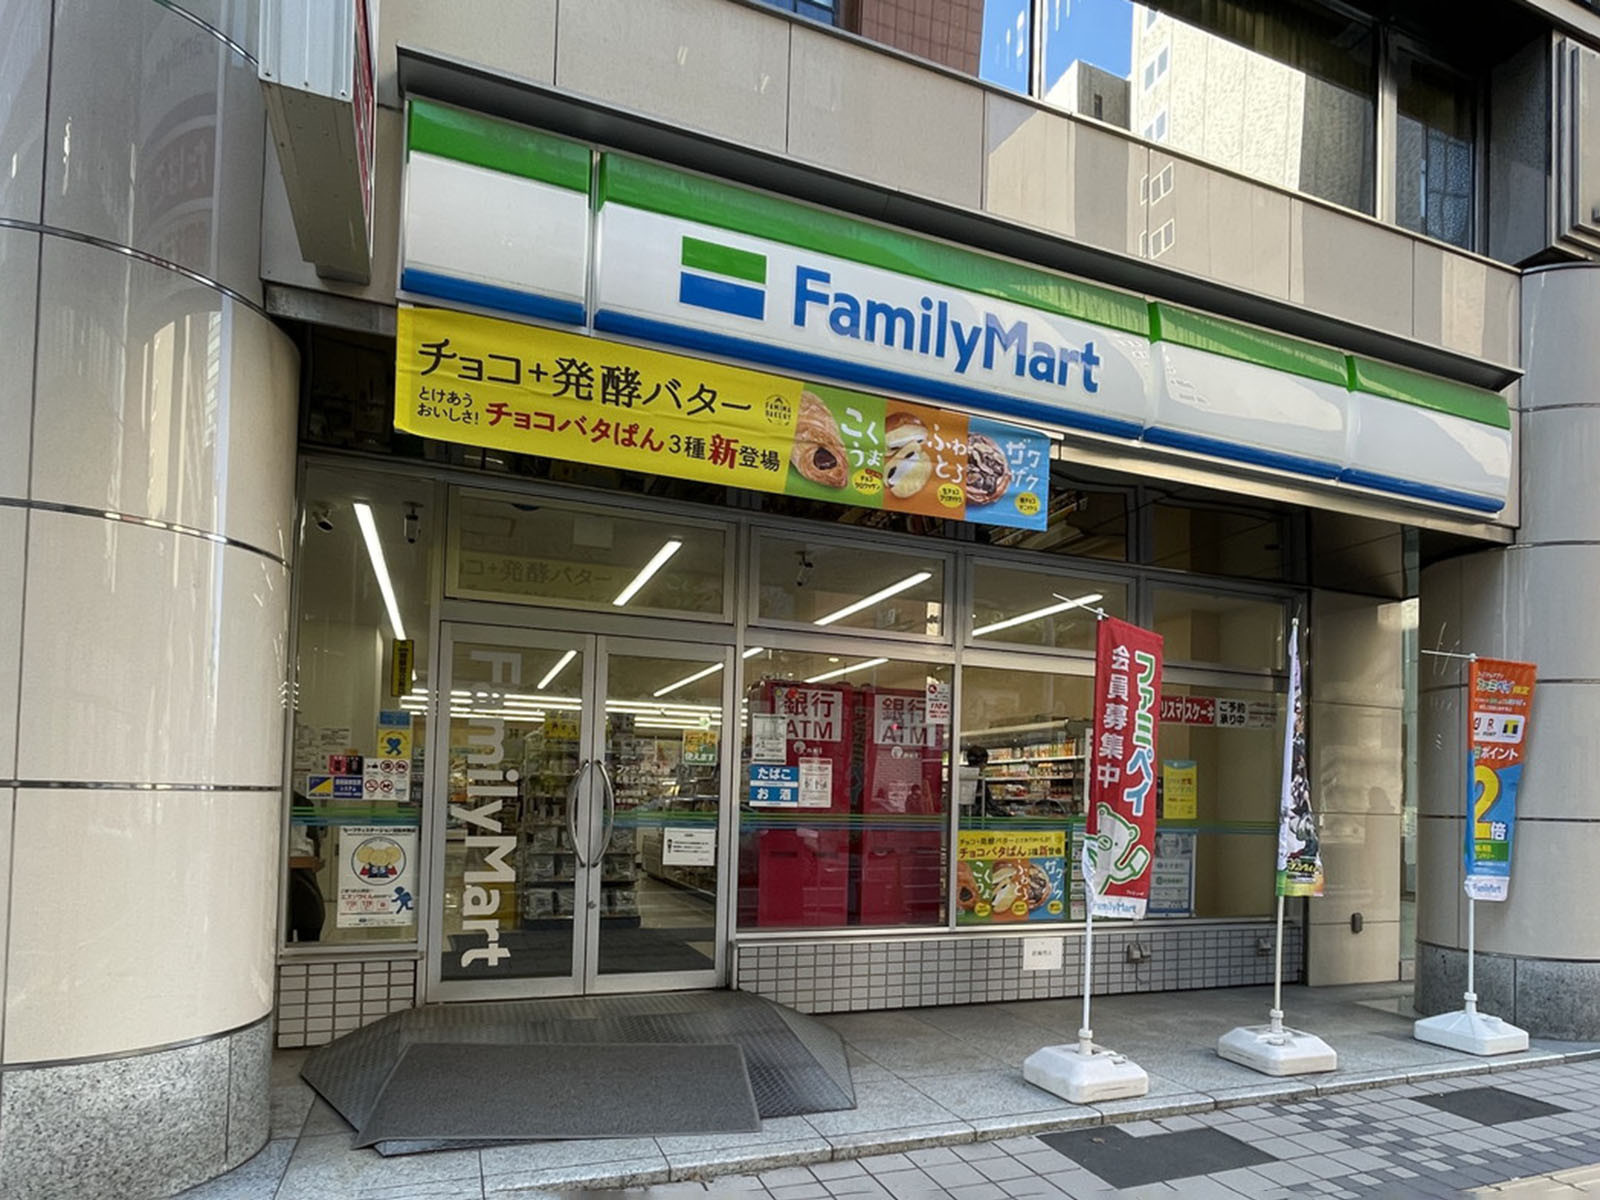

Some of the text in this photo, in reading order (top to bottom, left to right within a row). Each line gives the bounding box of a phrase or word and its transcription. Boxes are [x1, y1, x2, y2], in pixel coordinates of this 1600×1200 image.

[793, 264, 1102, 394] FamilyMart
[417, 338, 753, 417] チョコ+発酵バター
[418, 386, 474, 408] とけあう
[783, 691, 835, 719] 銀行
[1095, 644, 1131, 789] 会員募集中
[1160, 699, 1215, 721] リスマスケーキ
[1219, 700, 1247, 713] ご予約
[786, 719, 833, 740] ATM
[1122, 649, 1156, 818] ファミペイ
[757, 767, 792, 780] たばこ
[449, 650, 523, 968] FmilyMart
